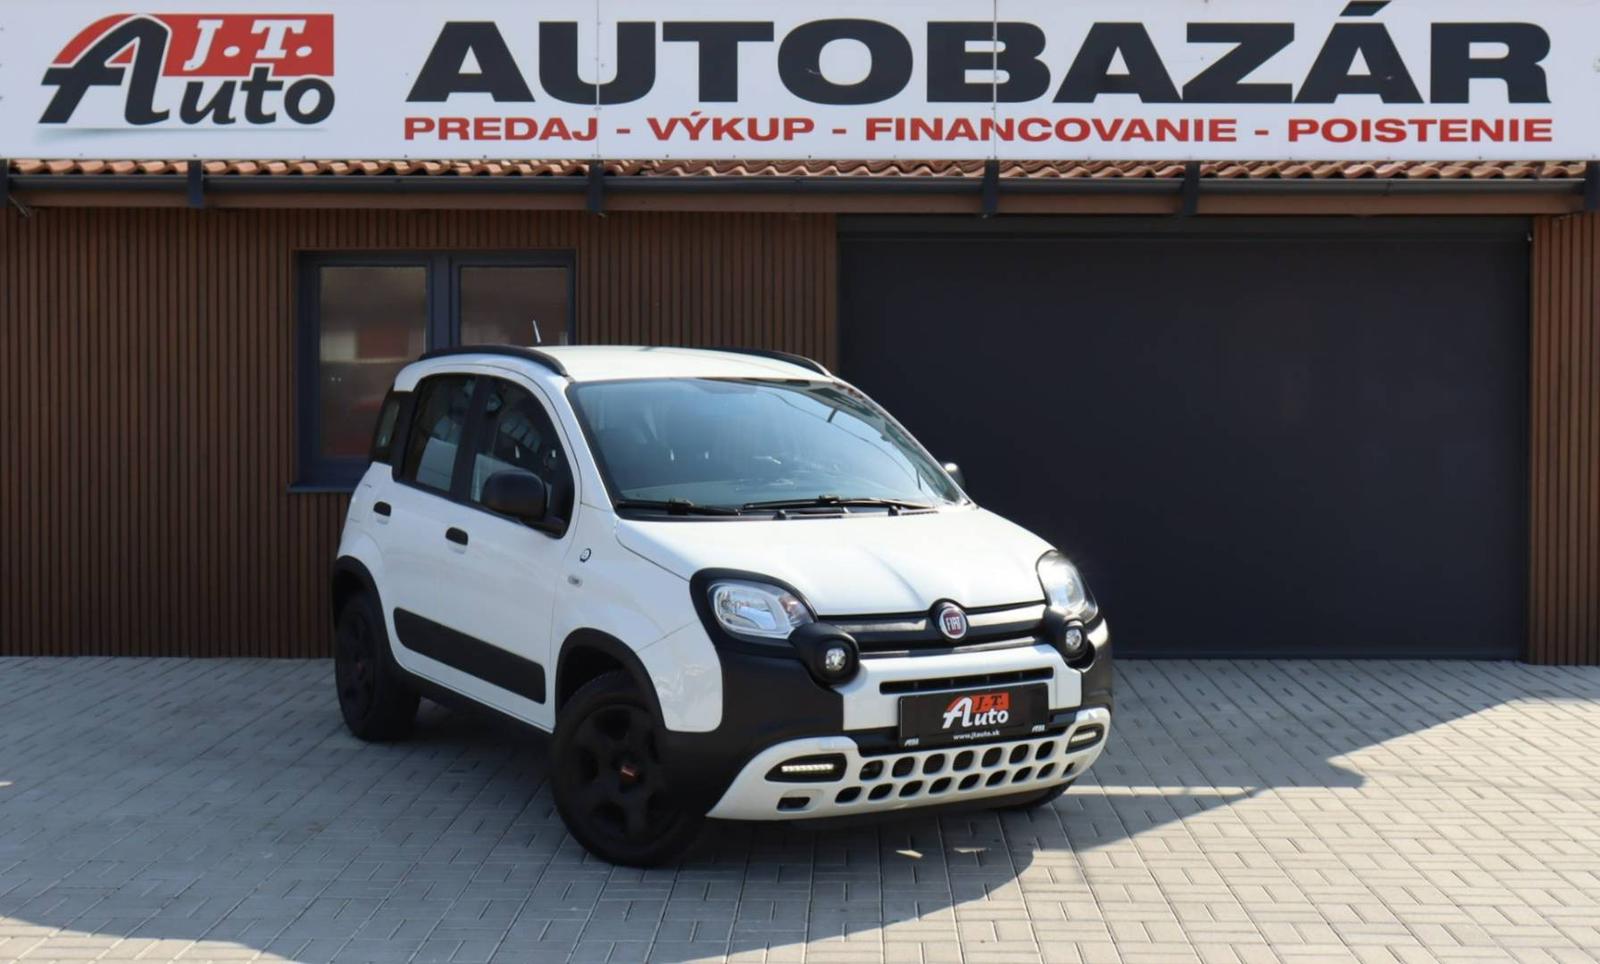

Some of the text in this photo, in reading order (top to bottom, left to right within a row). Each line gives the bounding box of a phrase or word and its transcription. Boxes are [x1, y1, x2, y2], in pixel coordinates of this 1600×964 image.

[184, 19, 312, 70] J.T.
[405, 1, 1551, 105] AUTOBAZÁR
[38, 17, 336, 126] Auto
[405, 117, 598, 141] PREDAJ
[648, 112, 814, 141] VÝKUP
[866, 117, 1236, 142] FINANCOVANIE
[1288, 118, 1552, 142] POISTENIE
[945, 616, 961, 631] FIAT
[942, 697, 1009, 729] Auto
[953, 729, 1000, 740] www.jtauto.sk
